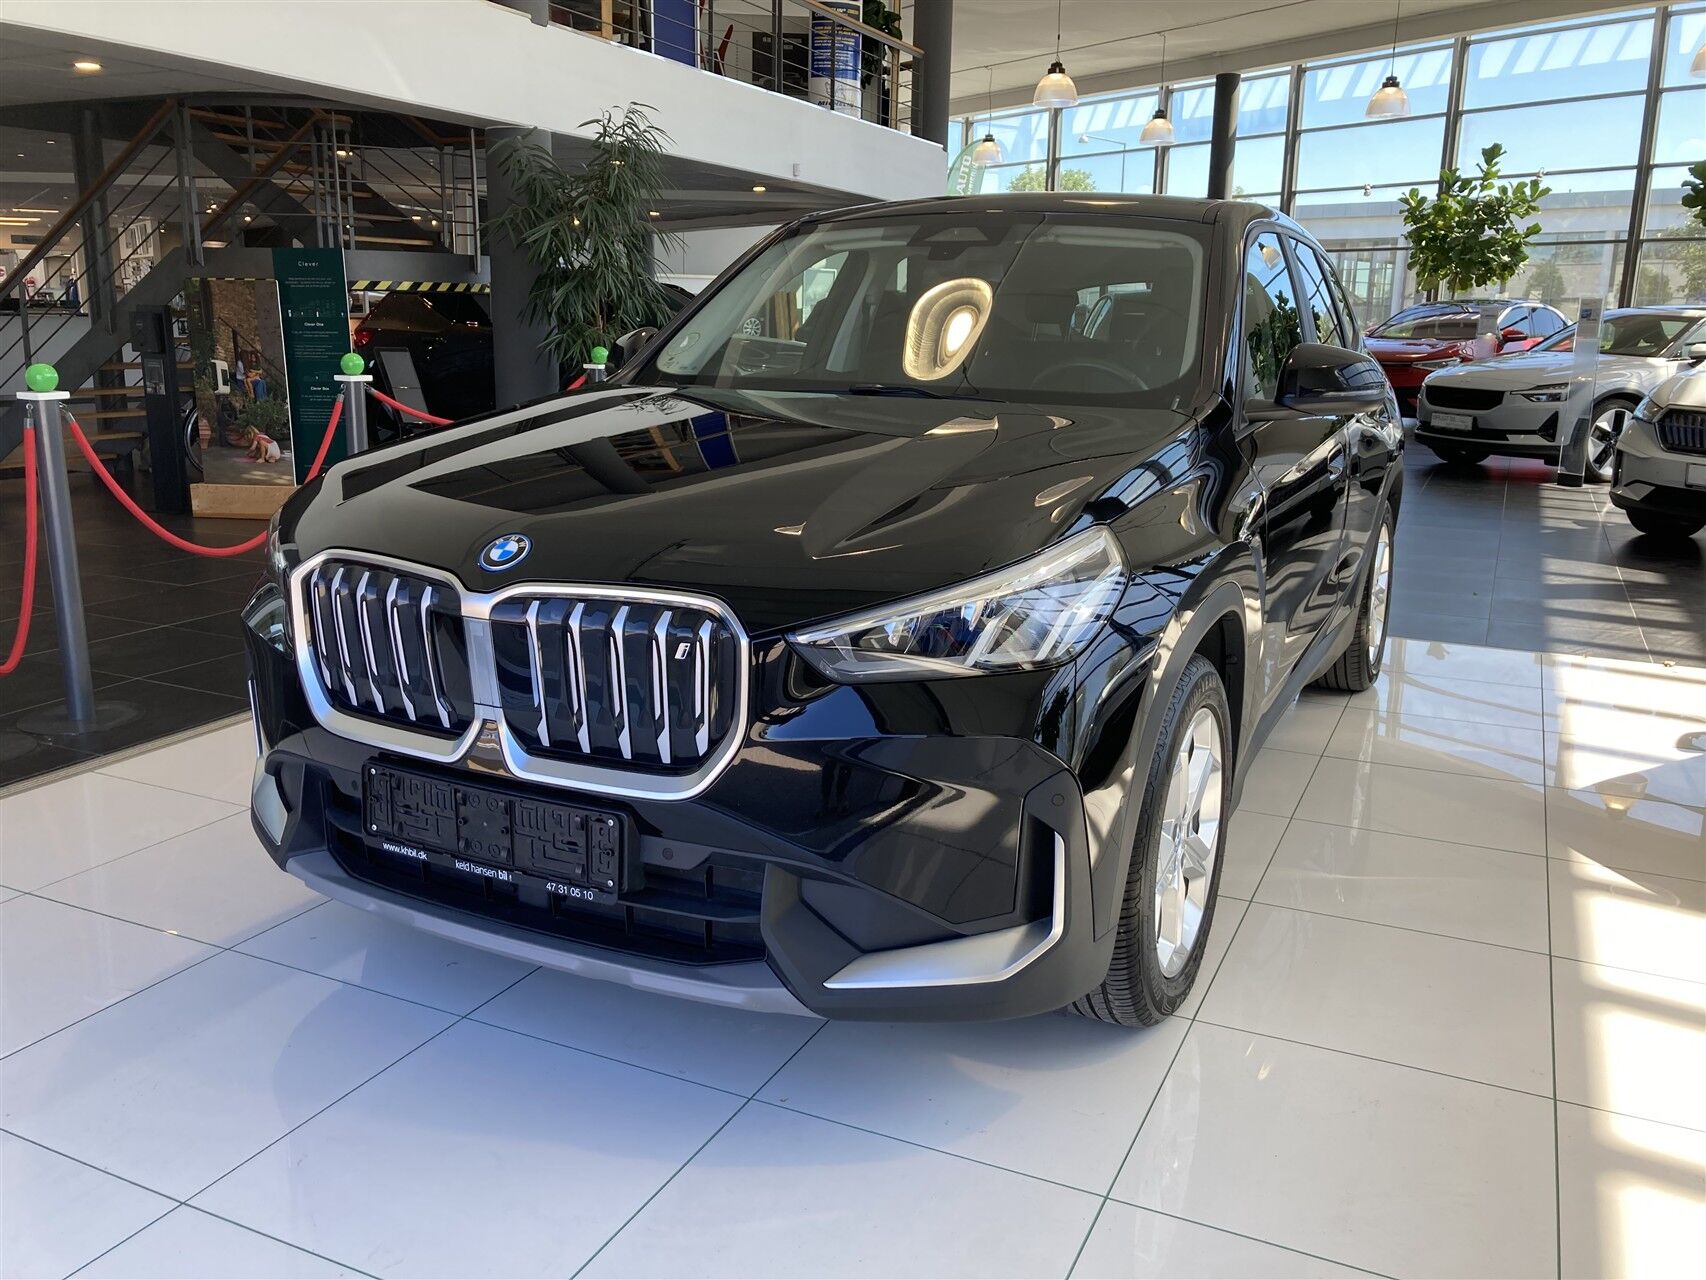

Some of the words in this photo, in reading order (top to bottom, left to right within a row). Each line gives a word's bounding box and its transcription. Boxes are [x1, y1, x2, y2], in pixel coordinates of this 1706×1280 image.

[382, 842, 428, 860] www.khbil.dk
[455, 859, 470, 871] keld
[470, 863, 498, 878] hansen
[546, 882, 556, 891] 47
[558, 884, 568, 896] 31
[570, 887, 581, 898] 05
[583, 890, 594, 900] 10
